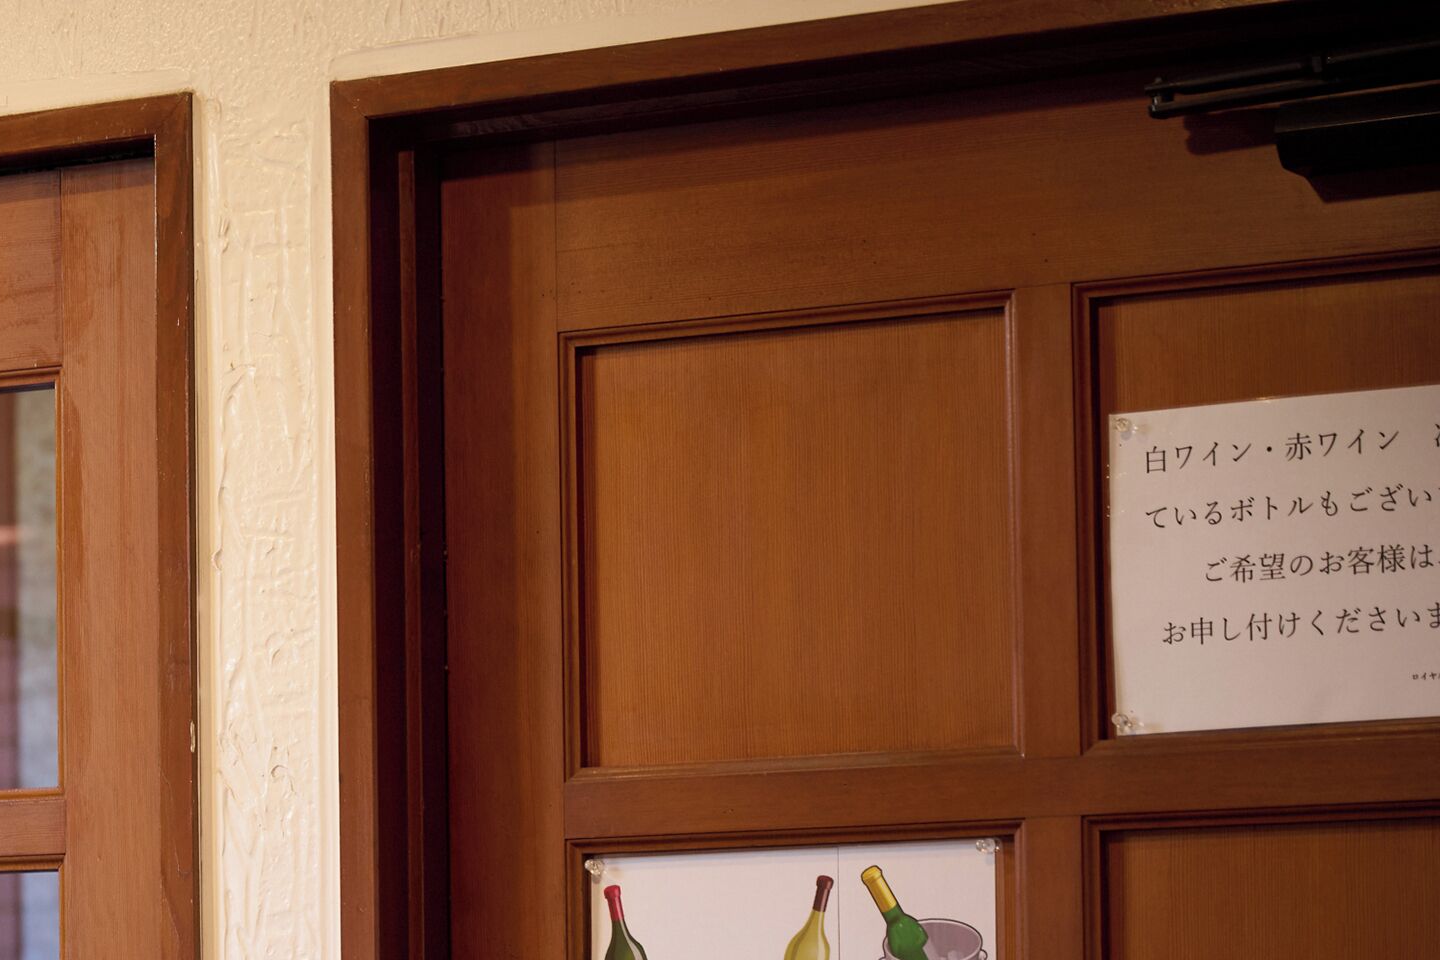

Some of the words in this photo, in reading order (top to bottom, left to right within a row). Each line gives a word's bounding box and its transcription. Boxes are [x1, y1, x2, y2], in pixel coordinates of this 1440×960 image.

[1145, 429, 1400, 475] 白ワイン・赤ワイン
[1145, 483, 1440, 530] ているボトルもござい
[1204, 543, 1440, 584] ご希望のお客様は
[1412, 672, 1440, 681] ロイヤ
